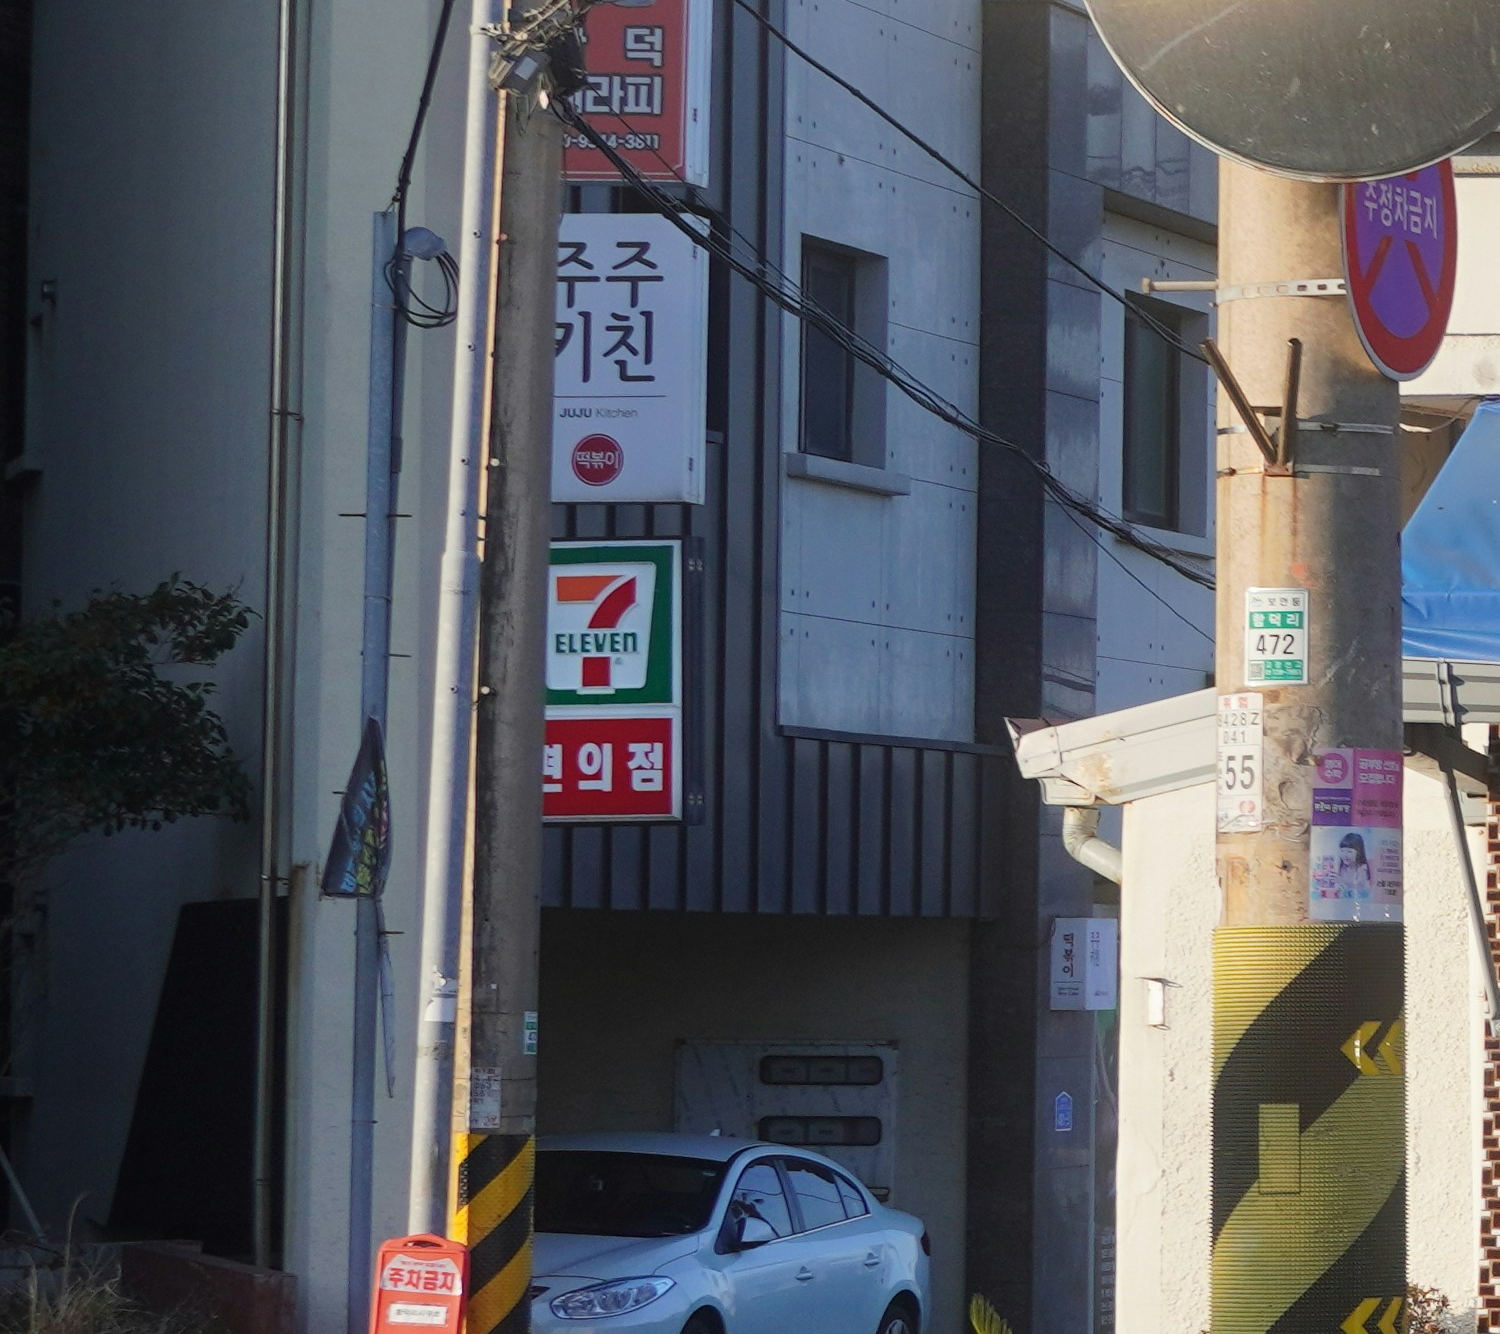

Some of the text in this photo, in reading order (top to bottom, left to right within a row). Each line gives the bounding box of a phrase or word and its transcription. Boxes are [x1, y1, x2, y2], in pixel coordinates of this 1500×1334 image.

[1364, 181, 1437, 240] 주정차금지
[557, 241, 664, 309] 주주
[555, 310, 656, 383] 키친
[559, 408, 638, 419] JUJU Kitchen
[1256, 633, 1296, 655] 472
[1225, 754, 1255, 791] 55
[389, 1267, 456, 1293] 주차금지
